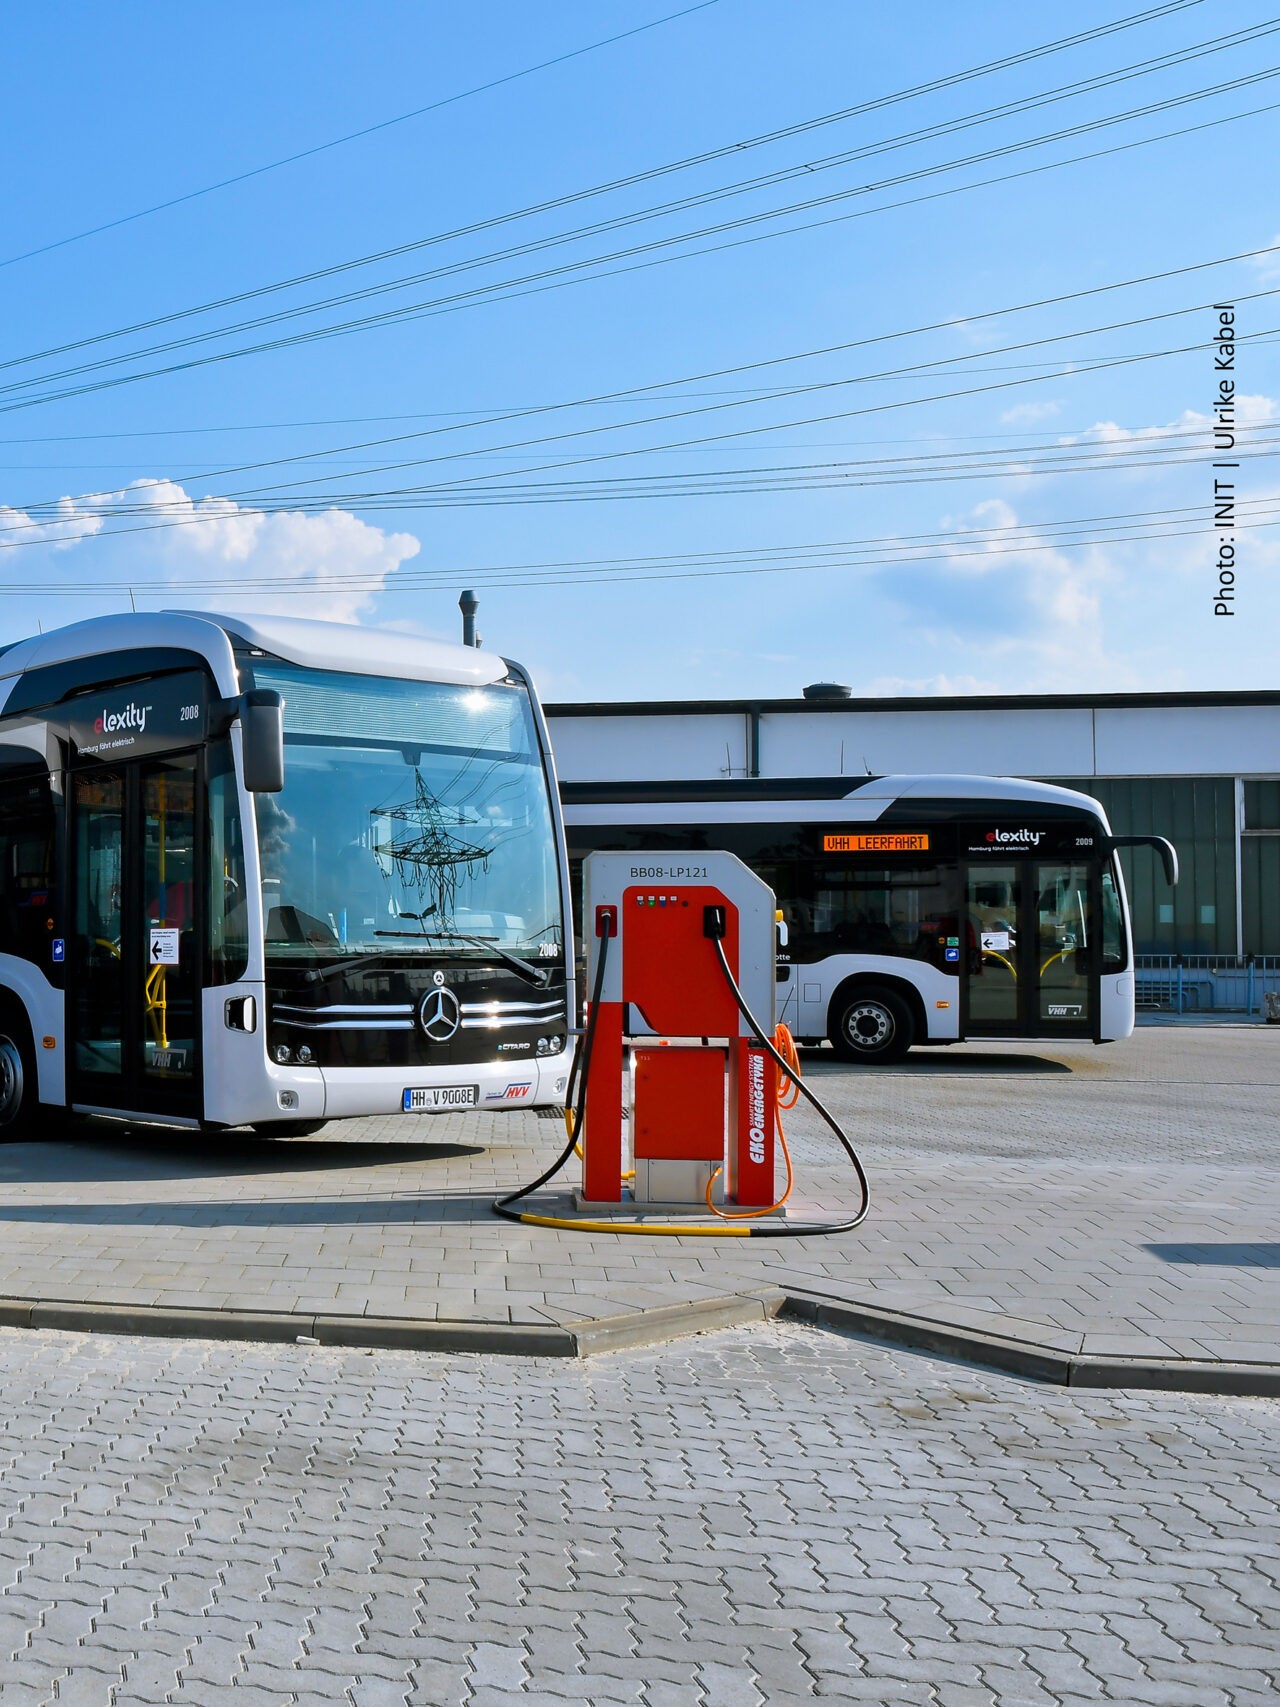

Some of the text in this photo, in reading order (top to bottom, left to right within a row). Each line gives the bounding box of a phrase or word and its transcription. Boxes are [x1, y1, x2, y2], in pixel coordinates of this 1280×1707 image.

[93, 702, 147, 734] elexity
[180, 704, 199, 721] 2008
[77, 743, 99, 754] Hamburg
[827, 836, 924, 850] VHH LEERFAHRT
[985, 828, 1040, 846] elexity
[1075, 837, 1093, 846] 2009
[630, 867, 708, 878] BB08-LP121
[539, 943, 558, 957] 2008
[1048, 1007, 1068, 1016] VHH
[411, 1090, 426, 1107] HH
[433, 1090, 440, 1105] V
[442, 1088, 473, 1105] 9008E
[506, 1085, 531, 1099] HVV
